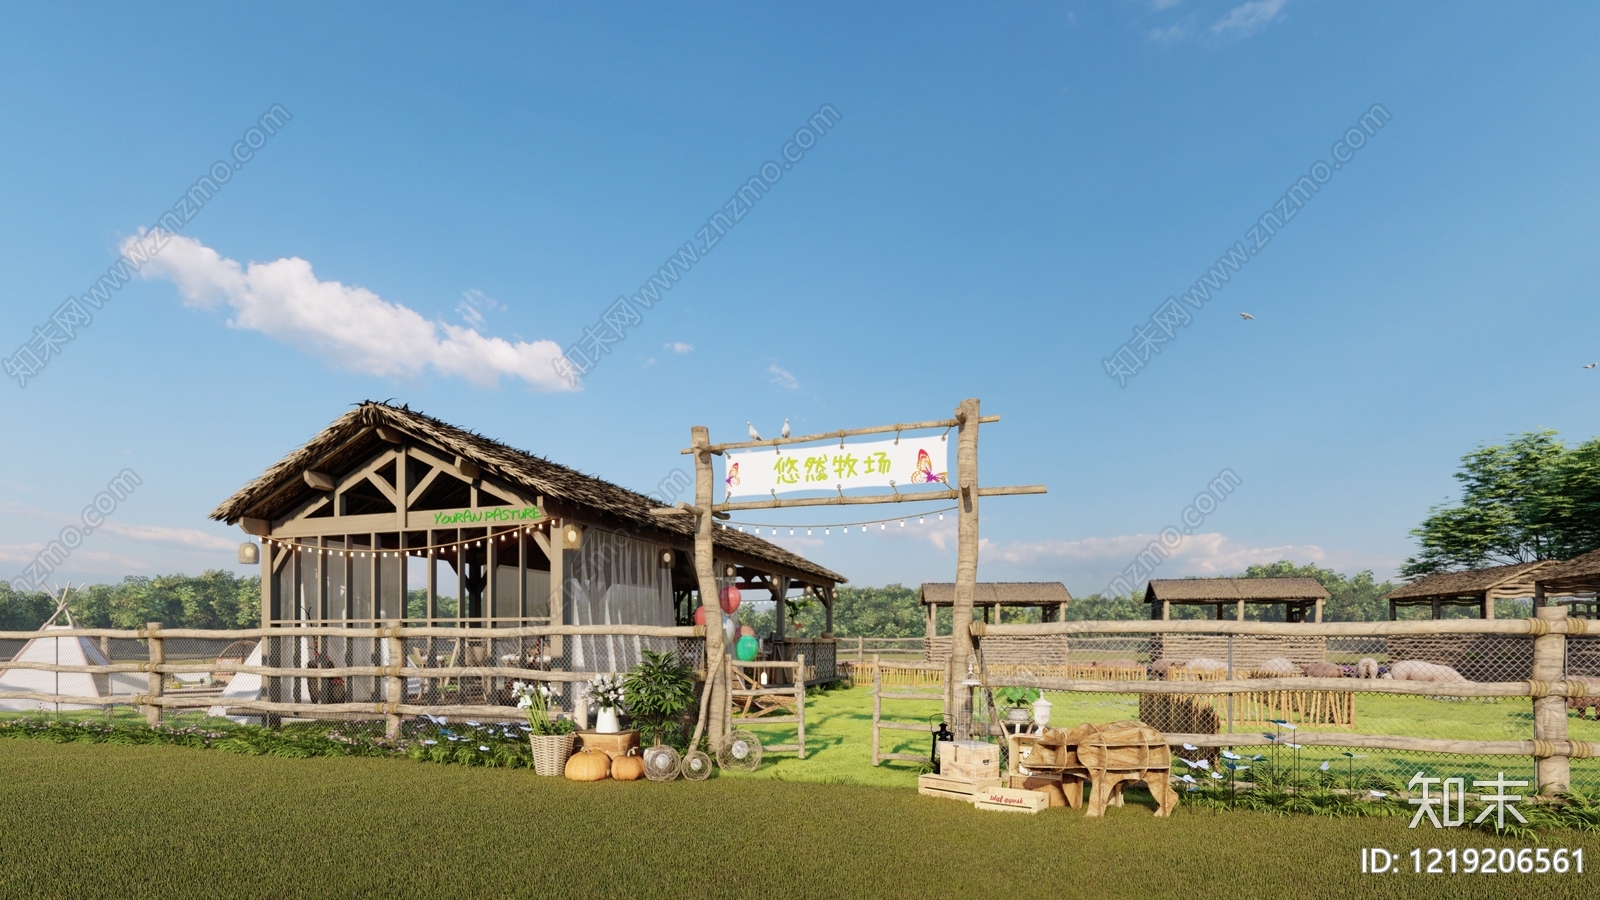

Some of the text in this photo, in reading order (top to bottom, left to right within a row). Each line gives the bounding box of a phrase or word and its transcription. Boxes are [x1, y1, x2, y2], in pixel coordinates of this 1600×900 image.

[773, 451, 892, 485] 悠然牧场
[484, 506, 543, 522] PASTURE
